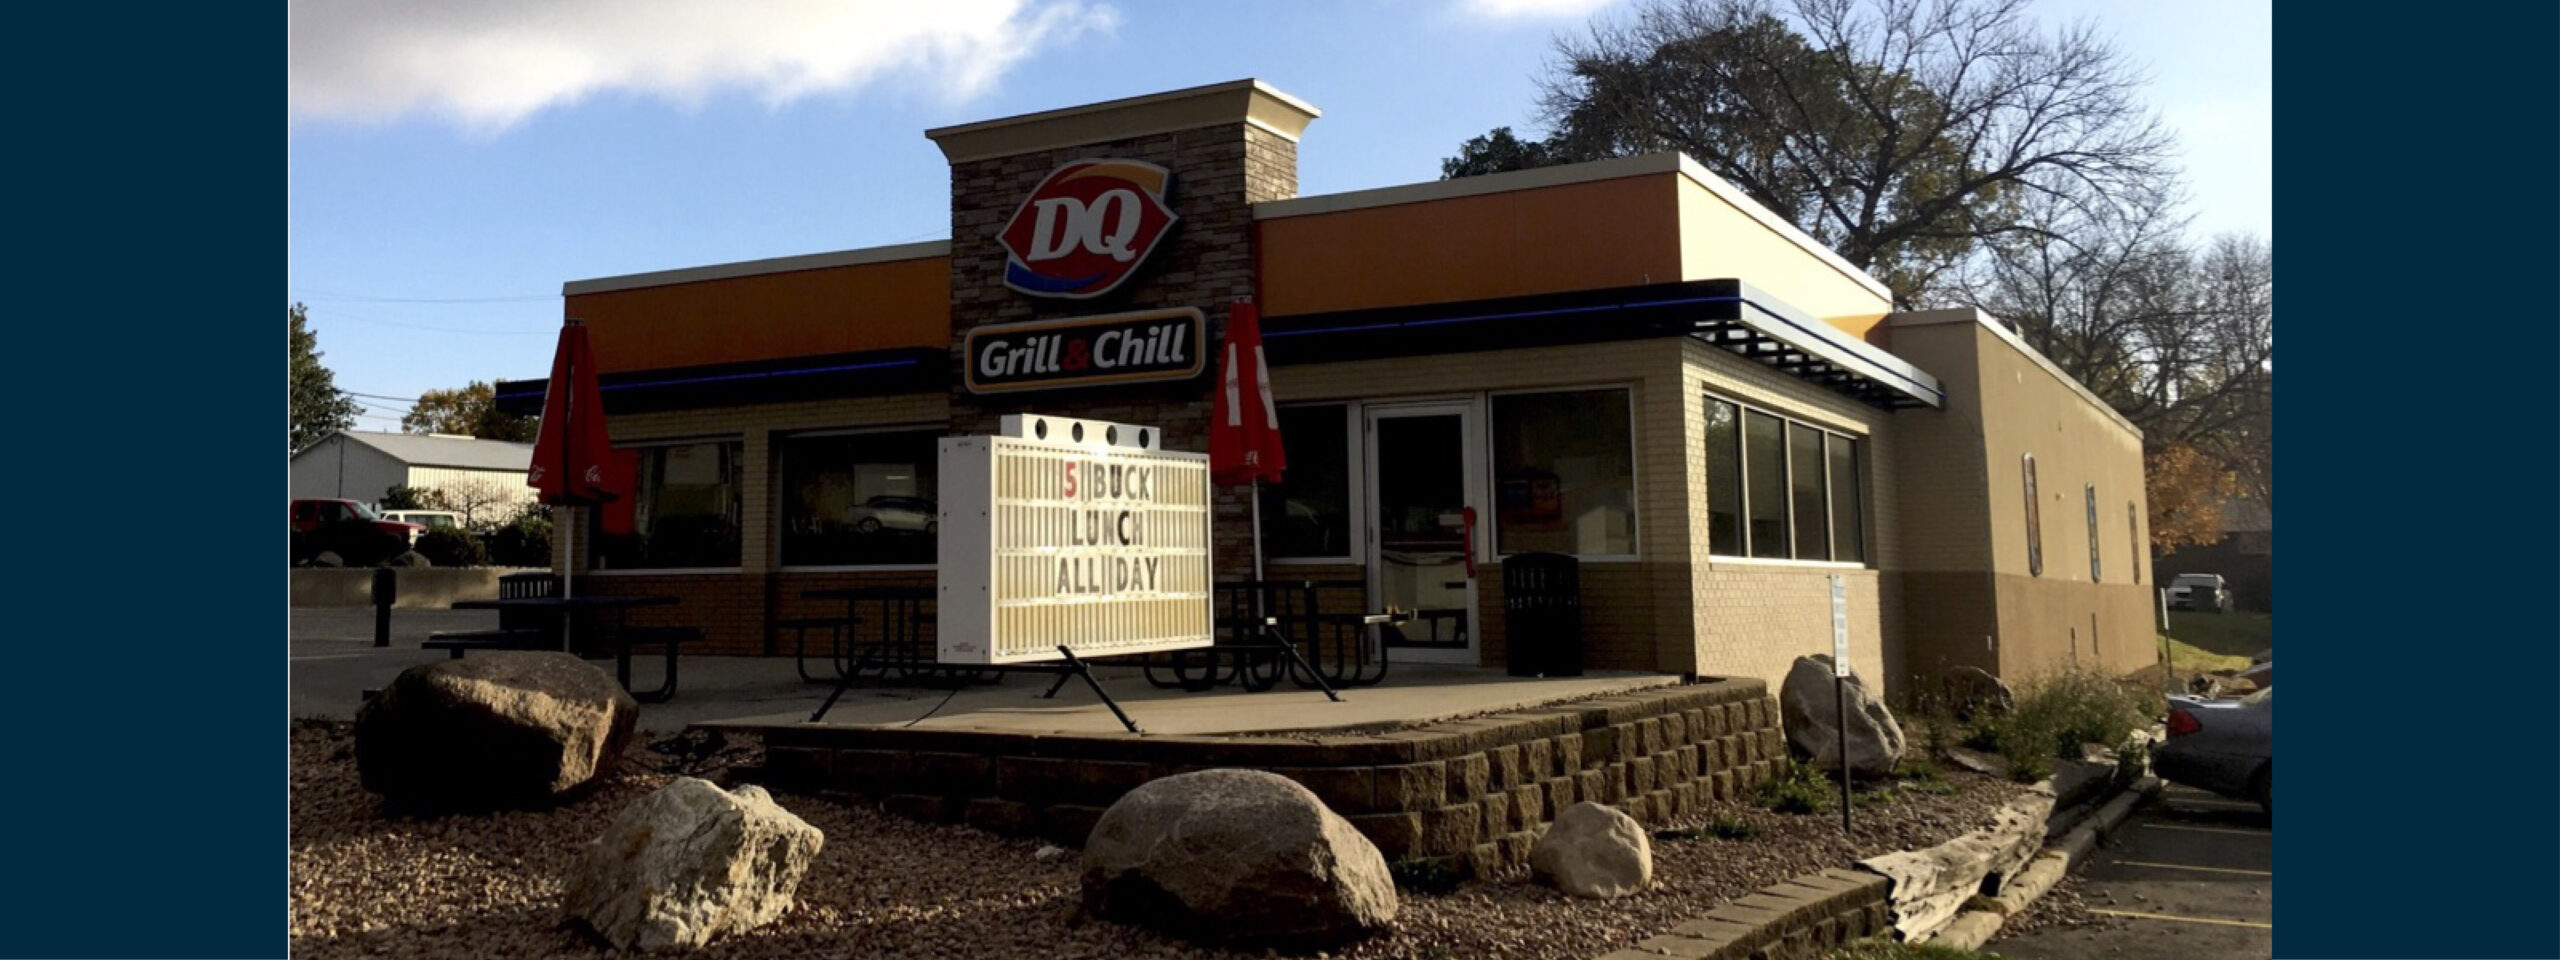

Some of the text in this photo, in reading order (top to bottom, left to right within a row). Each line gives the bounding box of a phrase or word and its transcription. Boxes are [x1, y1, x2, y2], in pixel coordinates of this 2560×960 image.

[1027, 188, 1142, 262] DQ
[980, 335, 1061, 377] Grill
[1093, 323, 1187, 368] Chill
[1064, 461, 1151, 500] 5 BUCK
[1071, 510, 1143, 546] LUNCH
[1057, 556, 1159, 594] ALL DAY
